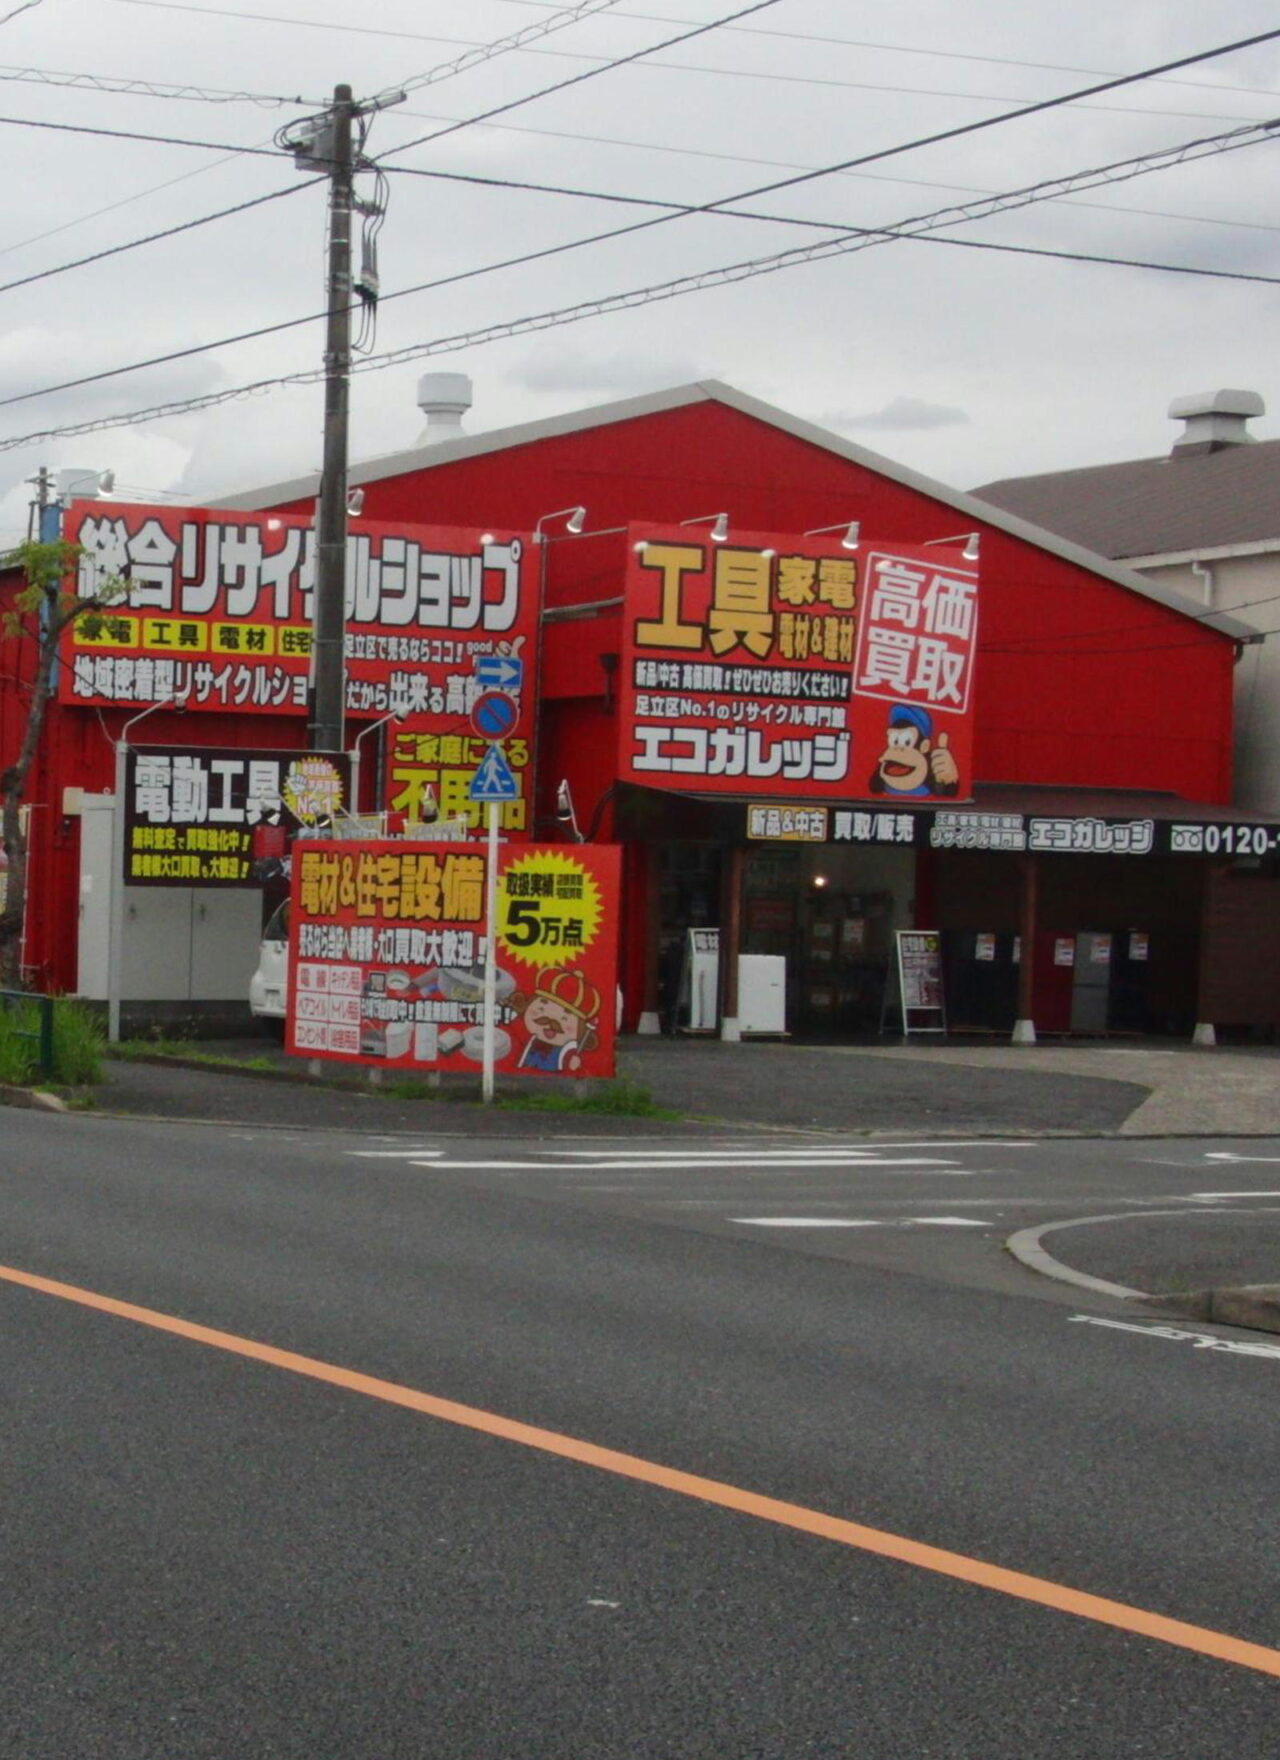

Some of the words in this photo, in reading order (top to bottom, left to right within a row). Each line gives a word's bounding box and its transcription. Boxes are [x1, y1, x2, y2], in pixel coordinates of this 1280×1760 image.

[635, 543, 775, 658] 工具
[778, 556, 856, 609] 家電
[870, 560, 978, 640] 高価
[149, 621, 200, 646] 工具
[219, 627, 267, 651] 電材
[859, 625, 966, 704] 買取
[394, 733, 529, 767] ご家庭にる
[631, 725, 852, 782] エコガレッジ
[135, 755, 282, 825] 電動工具
[1031, 819, 1153, 853] エコガレッジ
[1204, 825, 1280, 855] 0120-
[300, 851, 487, 922] 電材&住宅設備
[504, 900, 584, 947] 5万点
